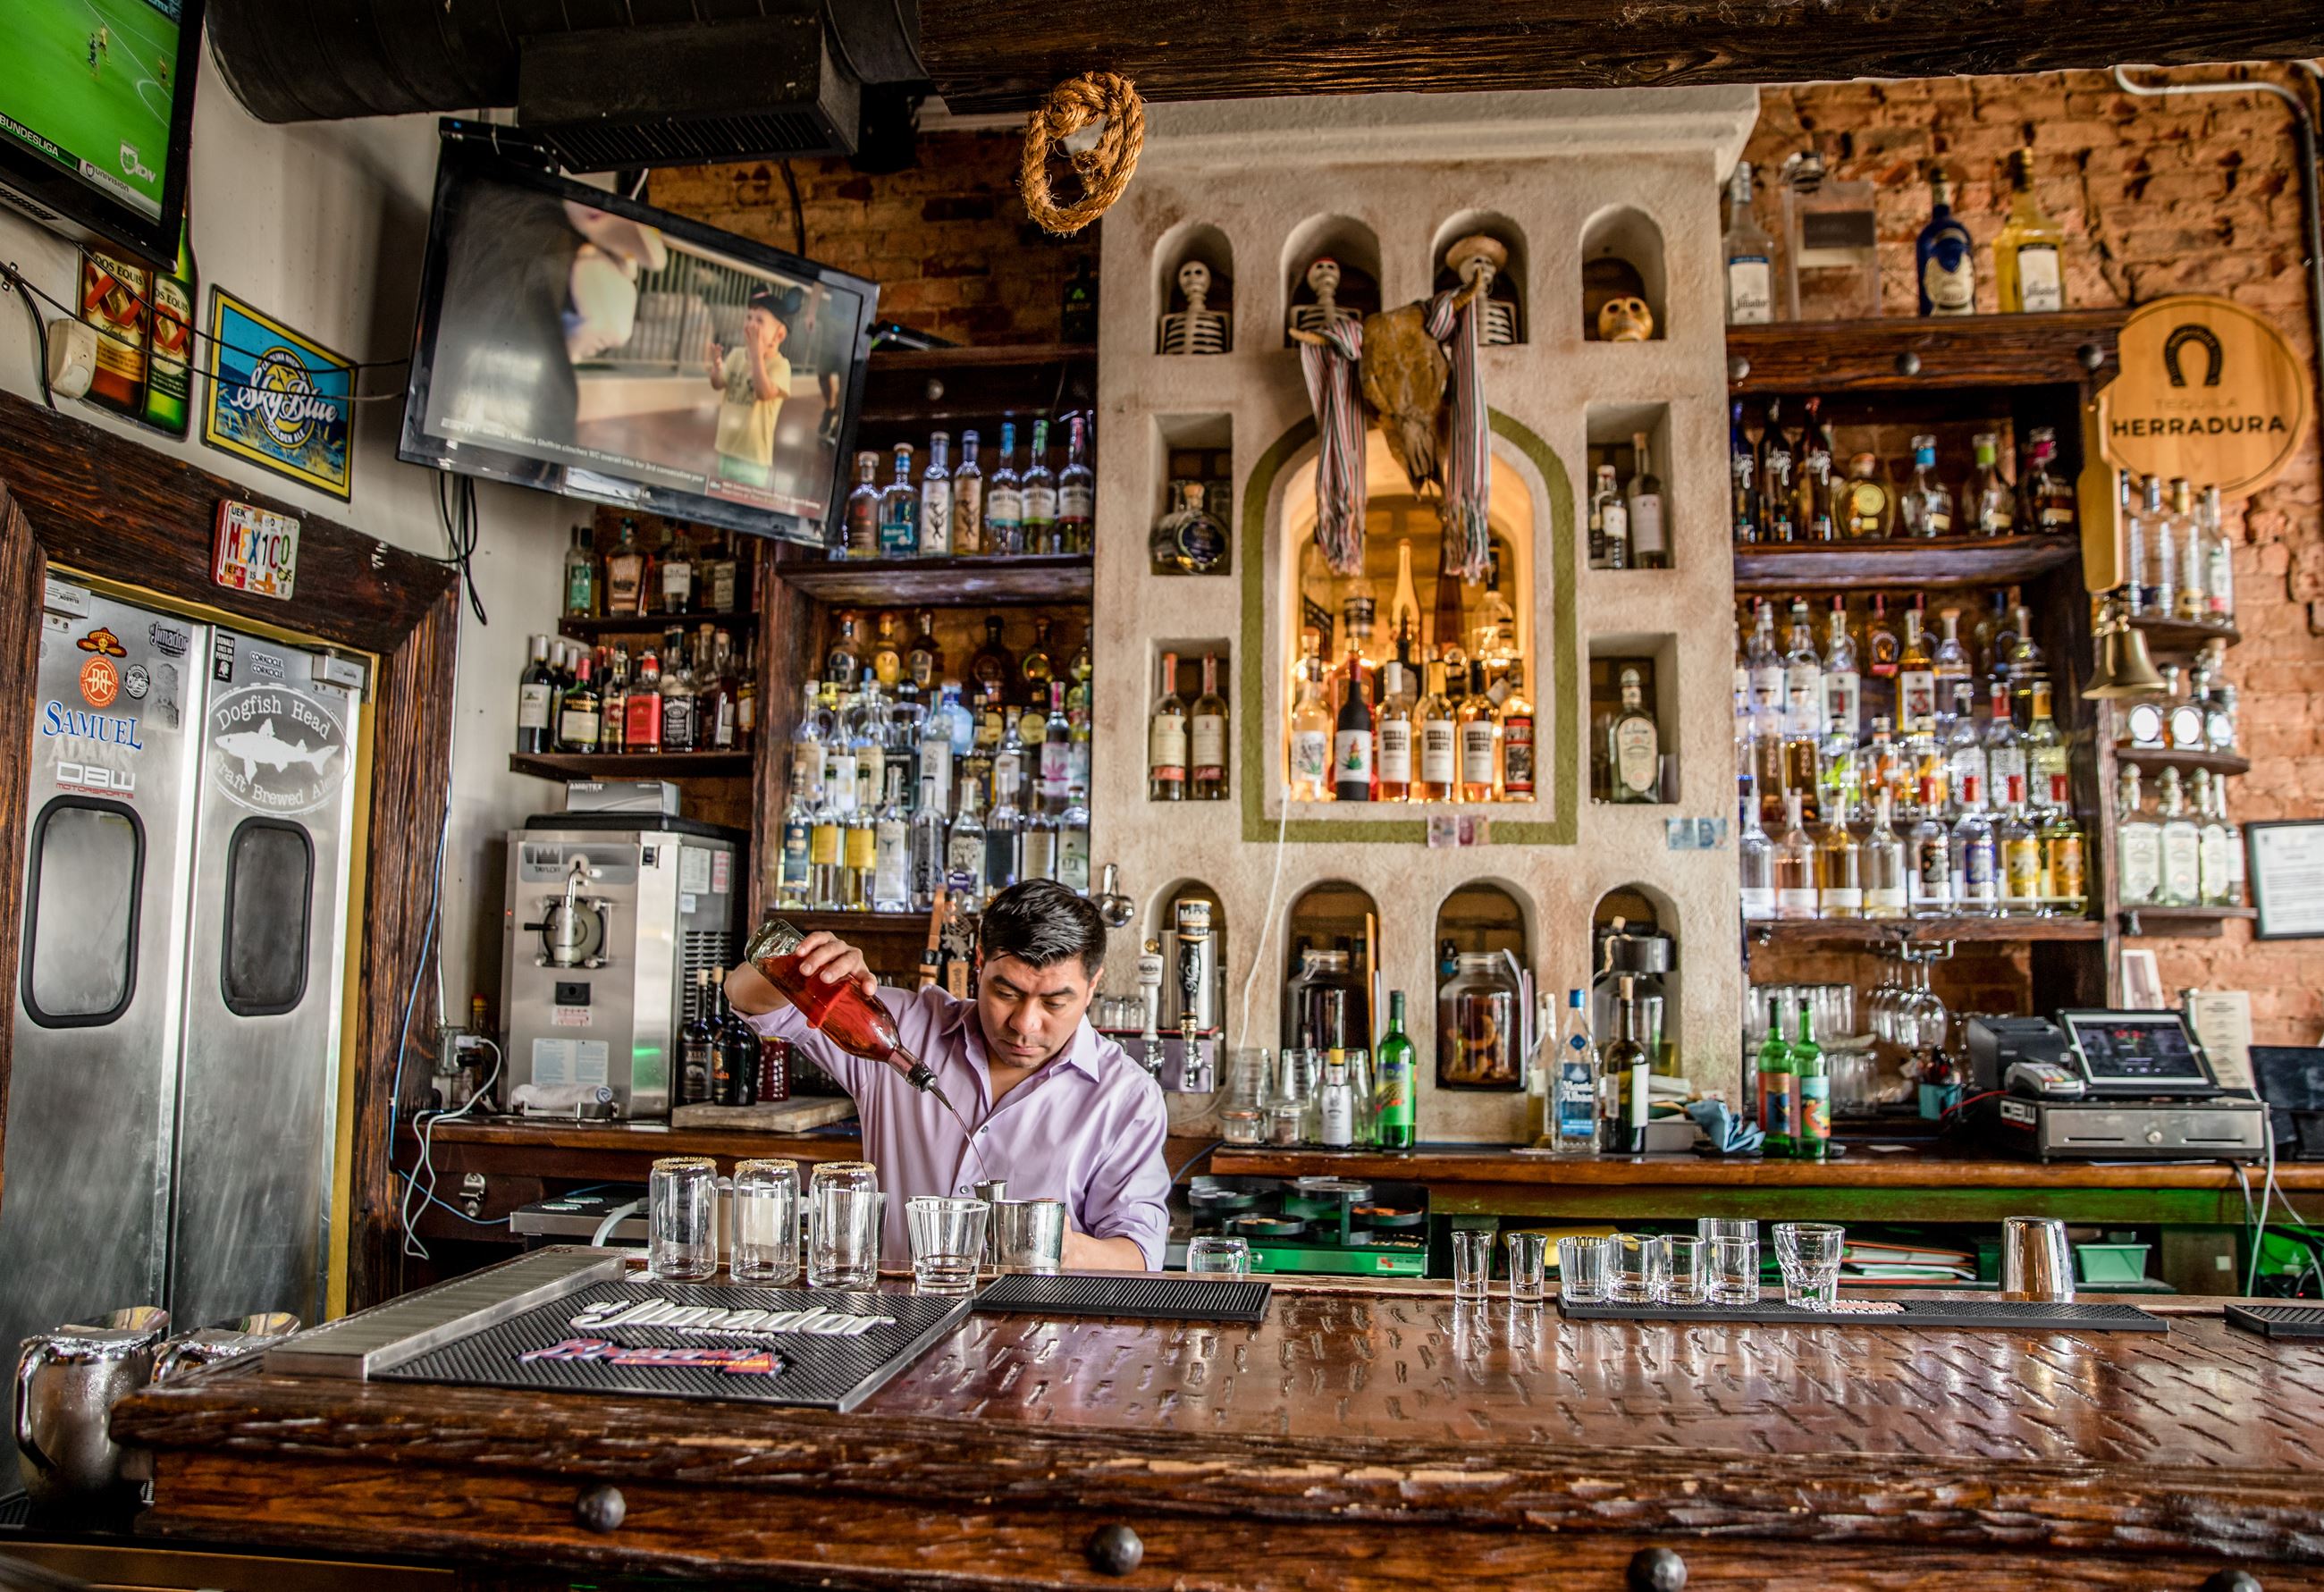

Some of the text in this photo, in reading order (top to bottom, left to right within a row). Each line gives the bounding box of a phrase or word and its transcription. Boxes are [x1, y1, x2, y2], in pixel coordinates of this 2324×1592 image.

[0, 114, 59, 157] BUNDESLIGA
[95, 255, 144, 286] DOS EQUIS
[166, 296, 189, 314] EQUIS
[230, 366, 283, 422] Sky
[278, 379, 339, 423] Blue
[2155, 397, 2238, 410] TEQUILA
[268, 424, 306, 443] GOLDEN ALE
[2111, 415, 2287, 437] HERRADURA
[150, 620, 189, 652] Jimador
[42, 701, 143, 751] SAMUEL
[215, 695, 331, 740] Dogfish Head
[55, 782, 134, 800] MOTORSPORTS
[251, 783, 305, 806] Brewed
[569, 1298, 896, 1336] Jimador
